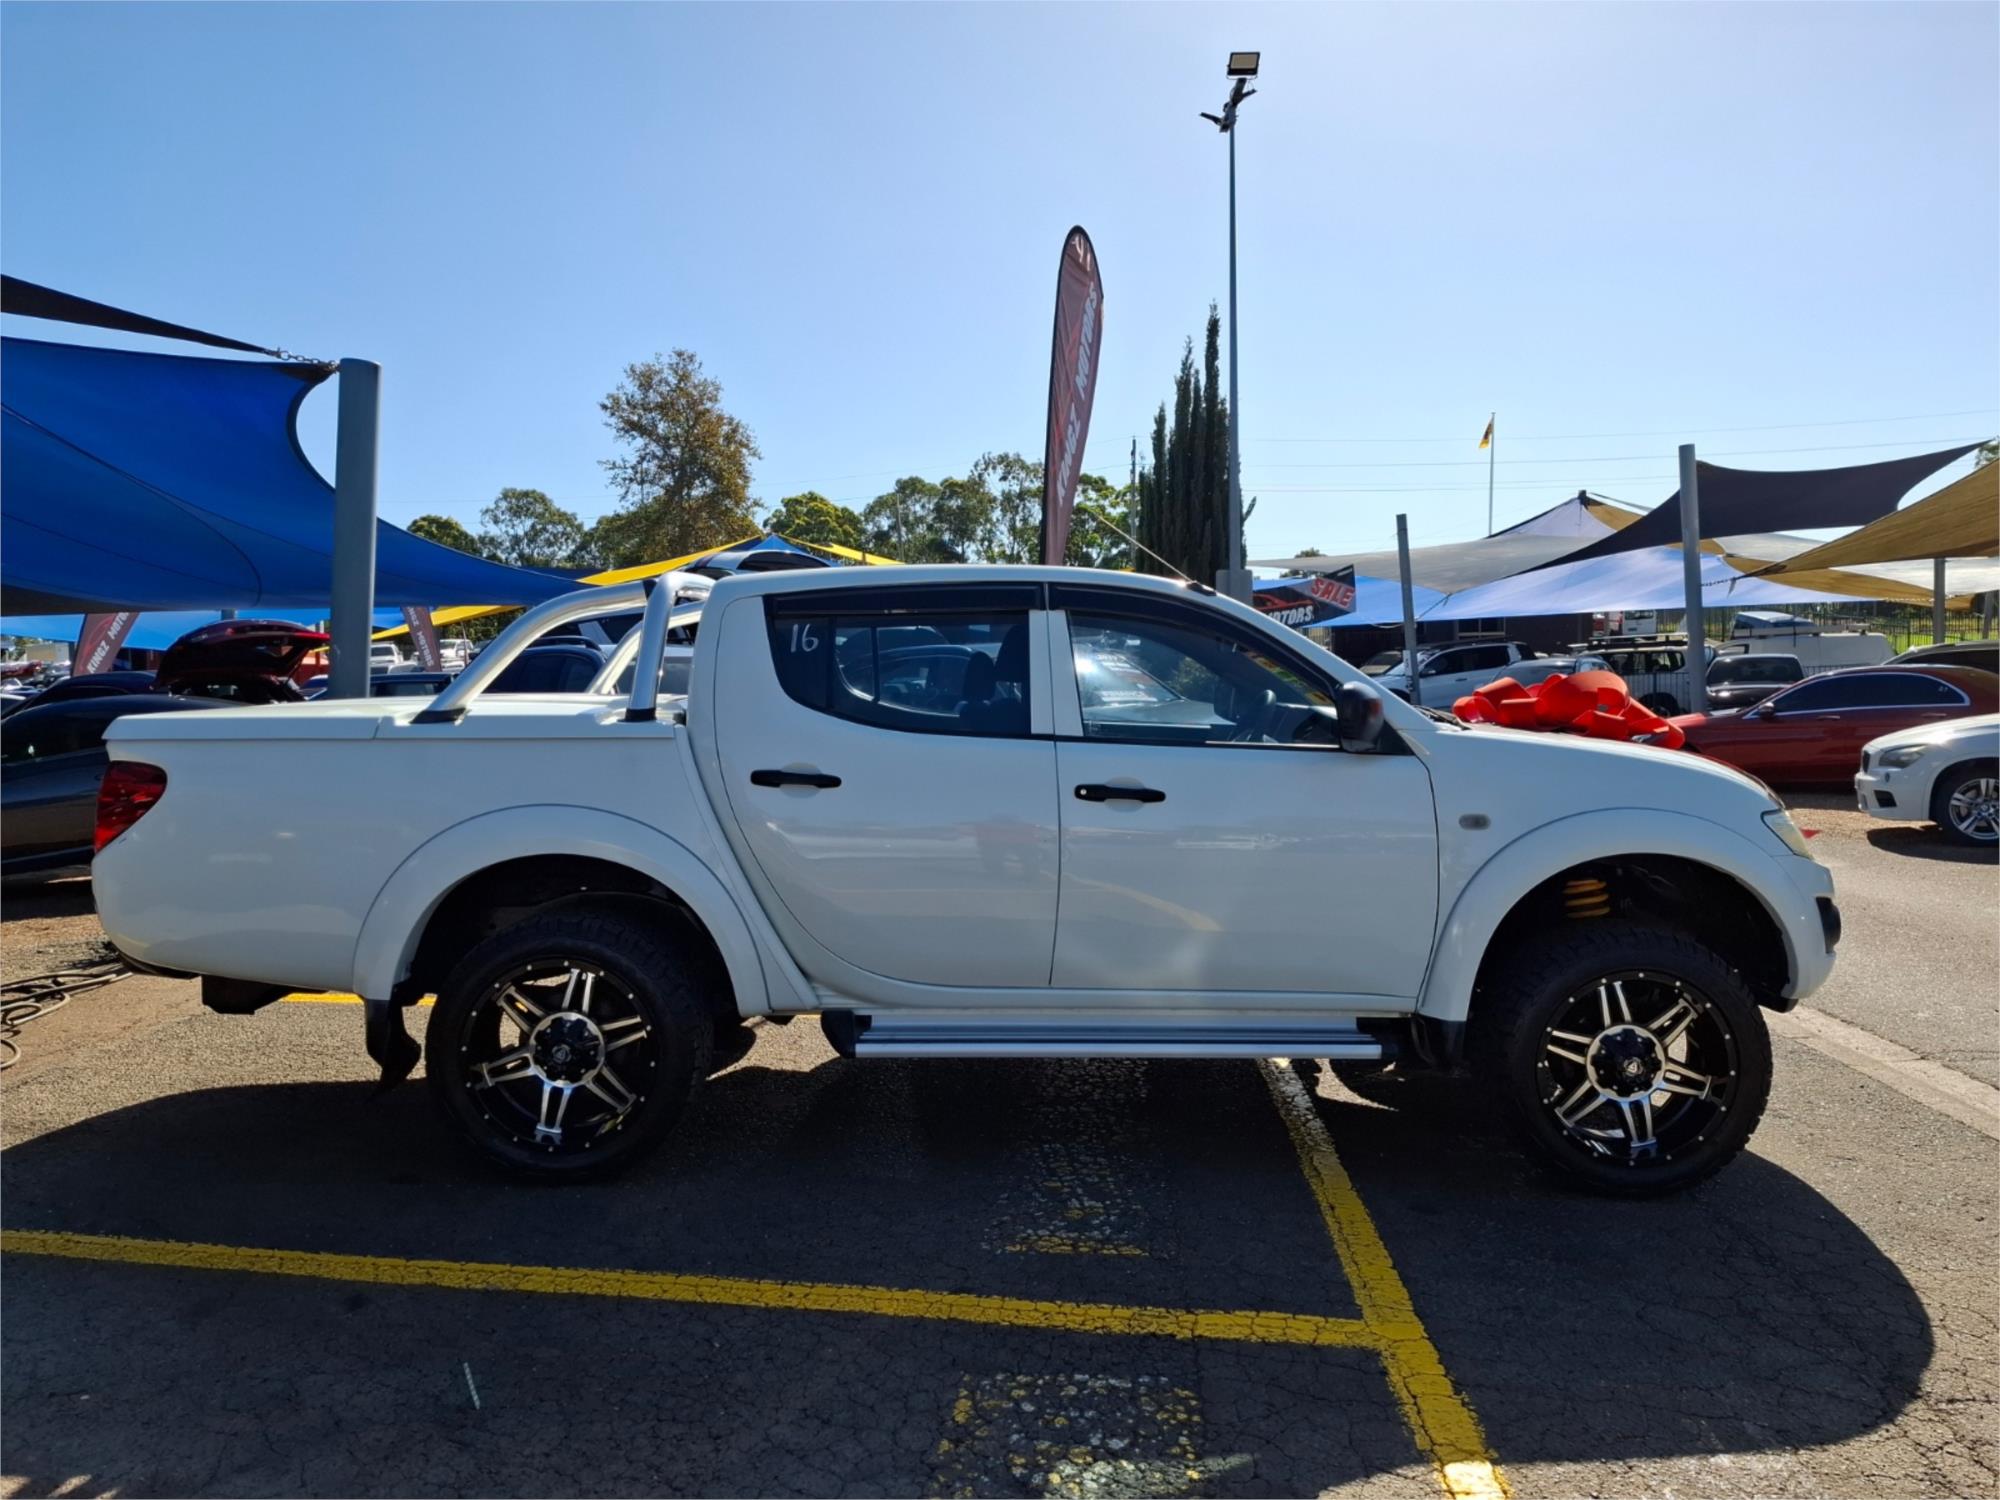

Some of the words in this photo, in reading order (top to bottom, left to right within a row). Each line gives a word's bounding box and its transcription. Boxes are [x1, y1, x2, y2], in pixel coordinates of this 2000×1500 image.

[1075, 281, 1097, 399] MOTORS
[1311, 578, 1355, 609] SALE
[1267, 605, 1314, 625] OTORS
[417, 631, 434, 667] MOTORS
[790, 623, 819, 652] 16
[86, 640, 110, 674] KINGZ
